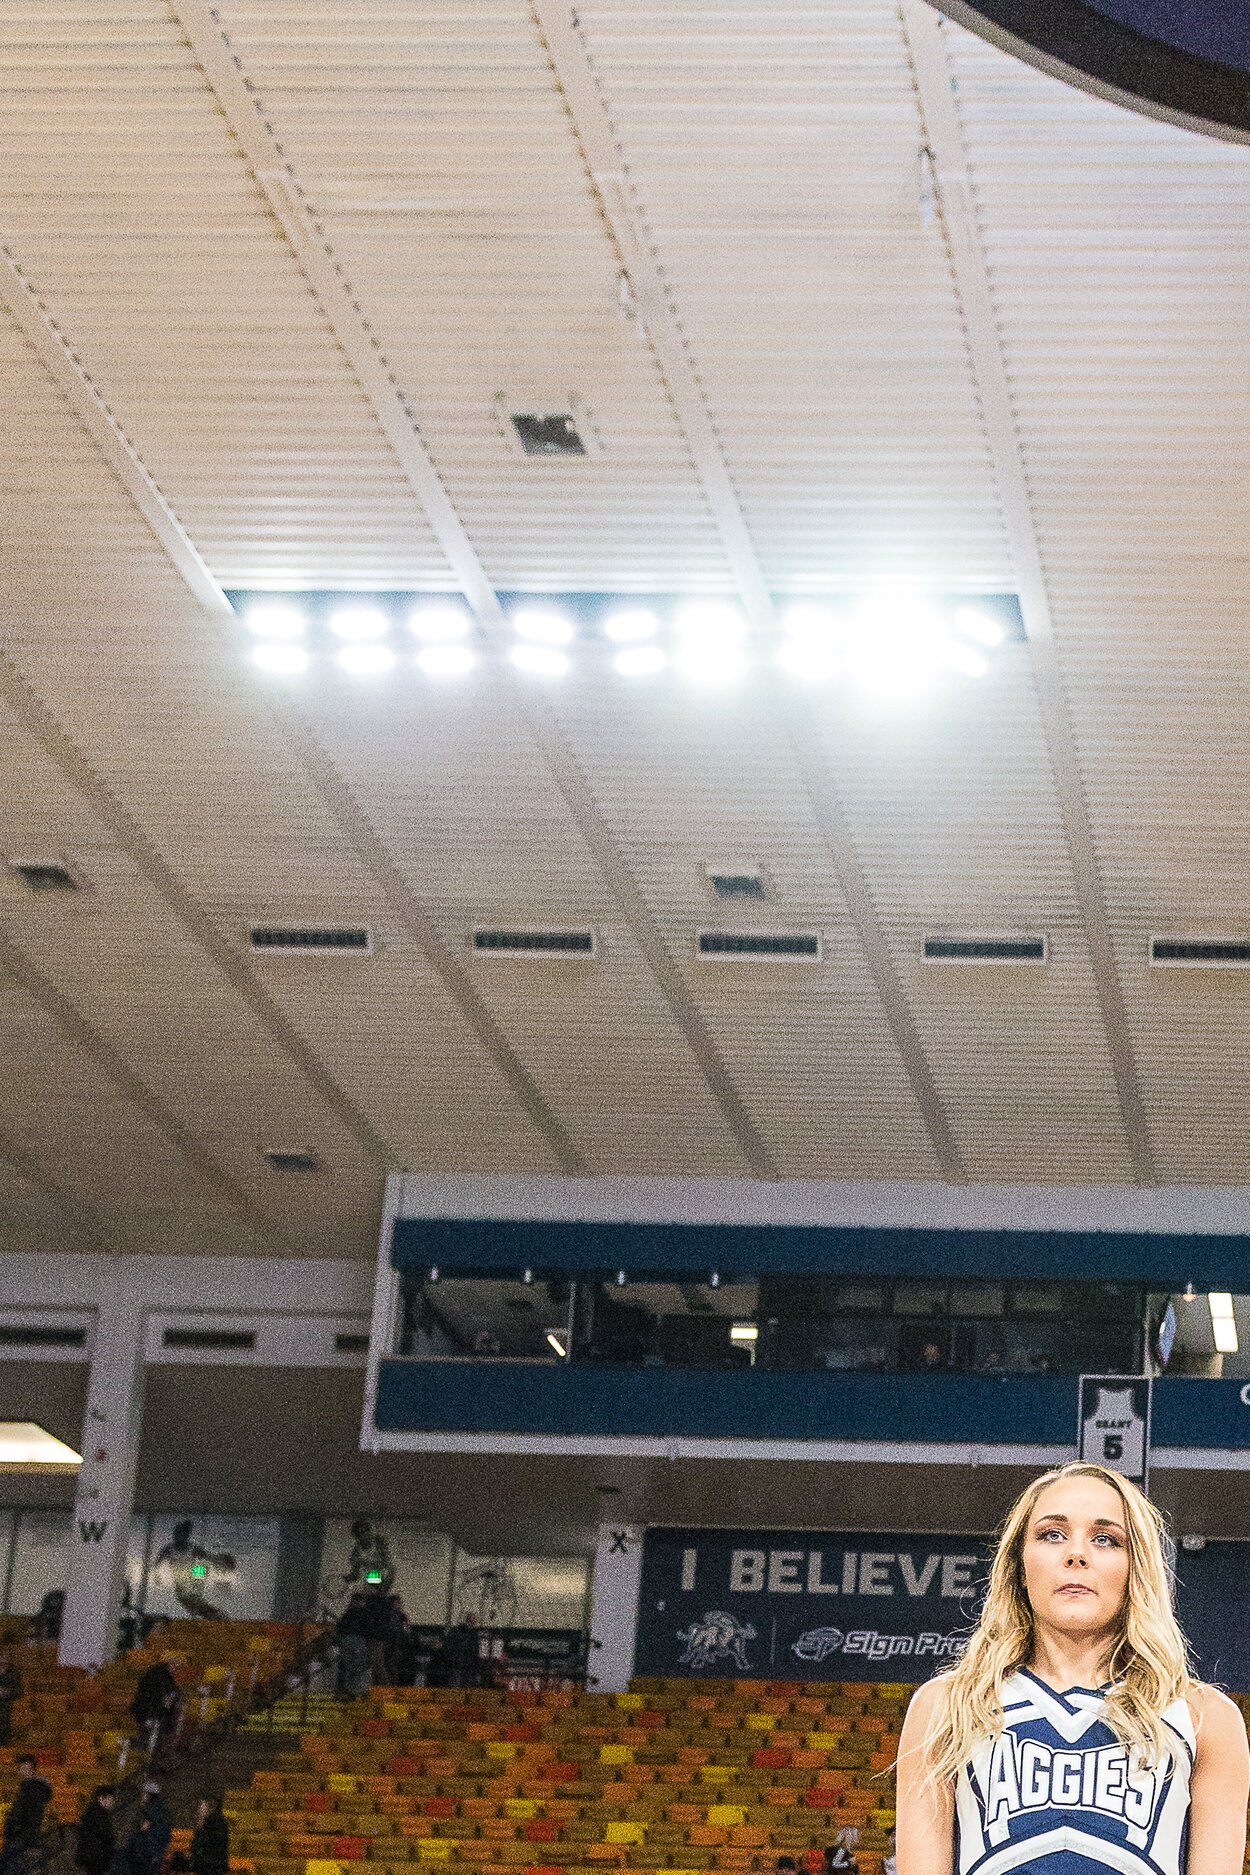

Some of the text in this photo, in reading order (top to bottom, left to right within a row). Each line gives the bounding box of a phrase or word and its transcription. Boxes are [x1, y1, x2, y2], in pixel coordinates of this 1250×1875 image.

[1103, 1434, 1122, 1459] 5
[79, 1521, 108, 1541] W
[610, 1531, 627, 1552] X
[681, 1549, 977, 1598] I BELIEVE
[843, 1630, 914, 1660] Sign
[985, 1728, 1157, 1830] AGGIES
